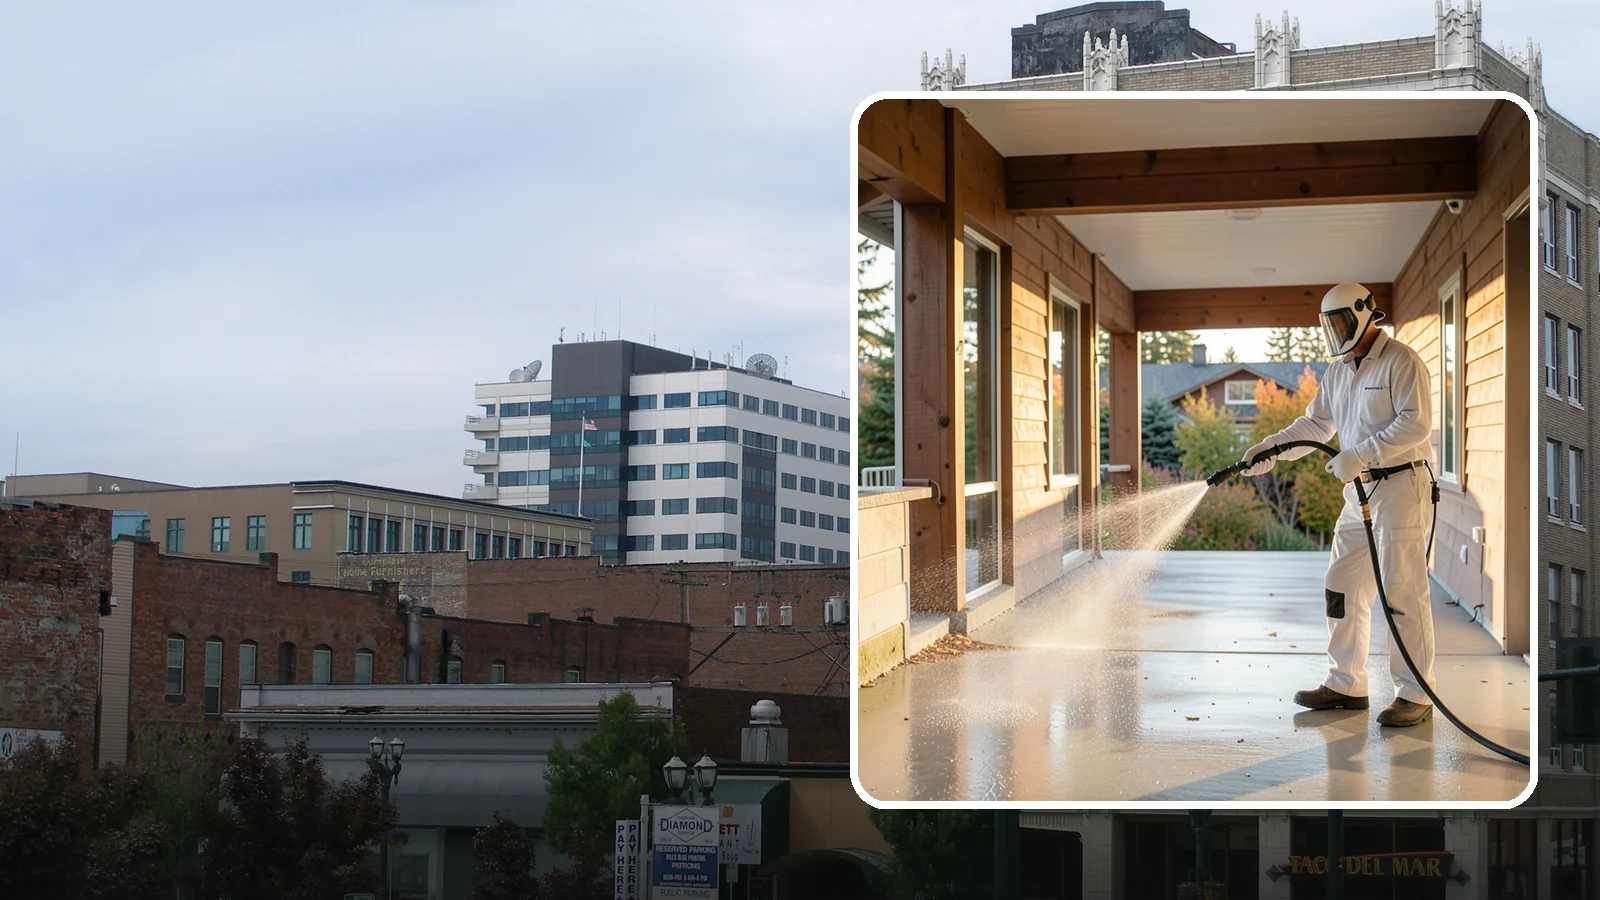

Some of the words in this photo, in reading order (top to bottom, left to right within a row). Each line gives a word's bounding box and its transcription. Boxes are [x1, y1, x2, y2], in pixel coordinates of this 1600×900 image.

[370, 566, 428, 576] Furnishers
[660, 818, 713, 833] DIAMOND
[1021, 815, 1070, 828] BUILDING
[617, 825, 625, 852] PAY
[628, 825, 636, 852] PAY
[722, 852, 739, 862] Soup
[671, 862, 701, 870] PATRONS
[1290, 856, 1330, 873] TAC
[1346, 857, 1385, 875] DEL
[1392, 858, 1443, 876] MAR
[617, 856, 625, 893] HERE
[628, 856, 636, 893] HERE
[660, 889, 681, 897] PUBLIC
[684, 890, 710, 898] PARKING
